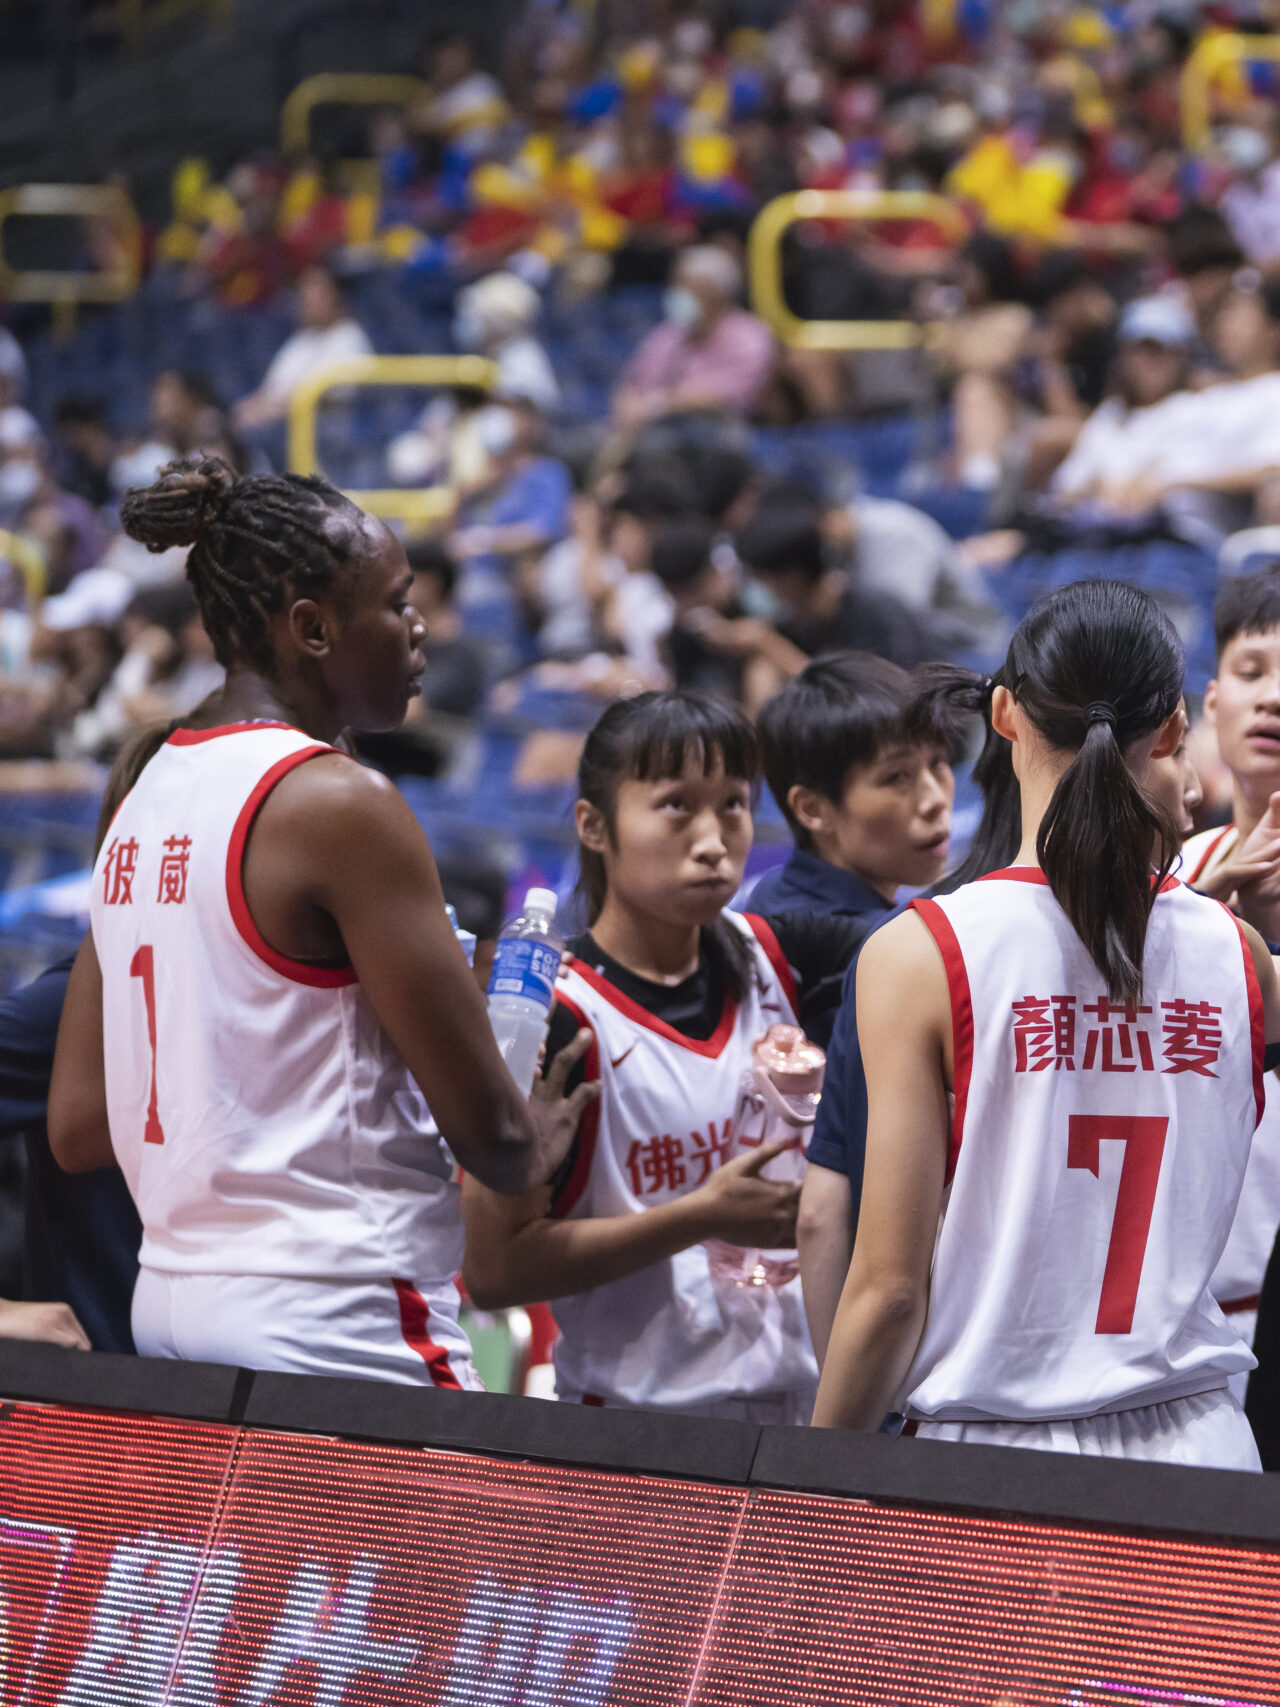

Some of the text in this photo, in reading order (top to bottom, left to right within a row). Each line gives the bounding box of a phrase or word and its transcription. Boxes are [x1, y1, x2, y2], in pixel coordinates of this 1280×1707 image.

[129, 945, 165, 1145] 1
[1011, 995, 1223, 1079] 顏芯菱
[1066, 1114, 1170, 1335] 7
